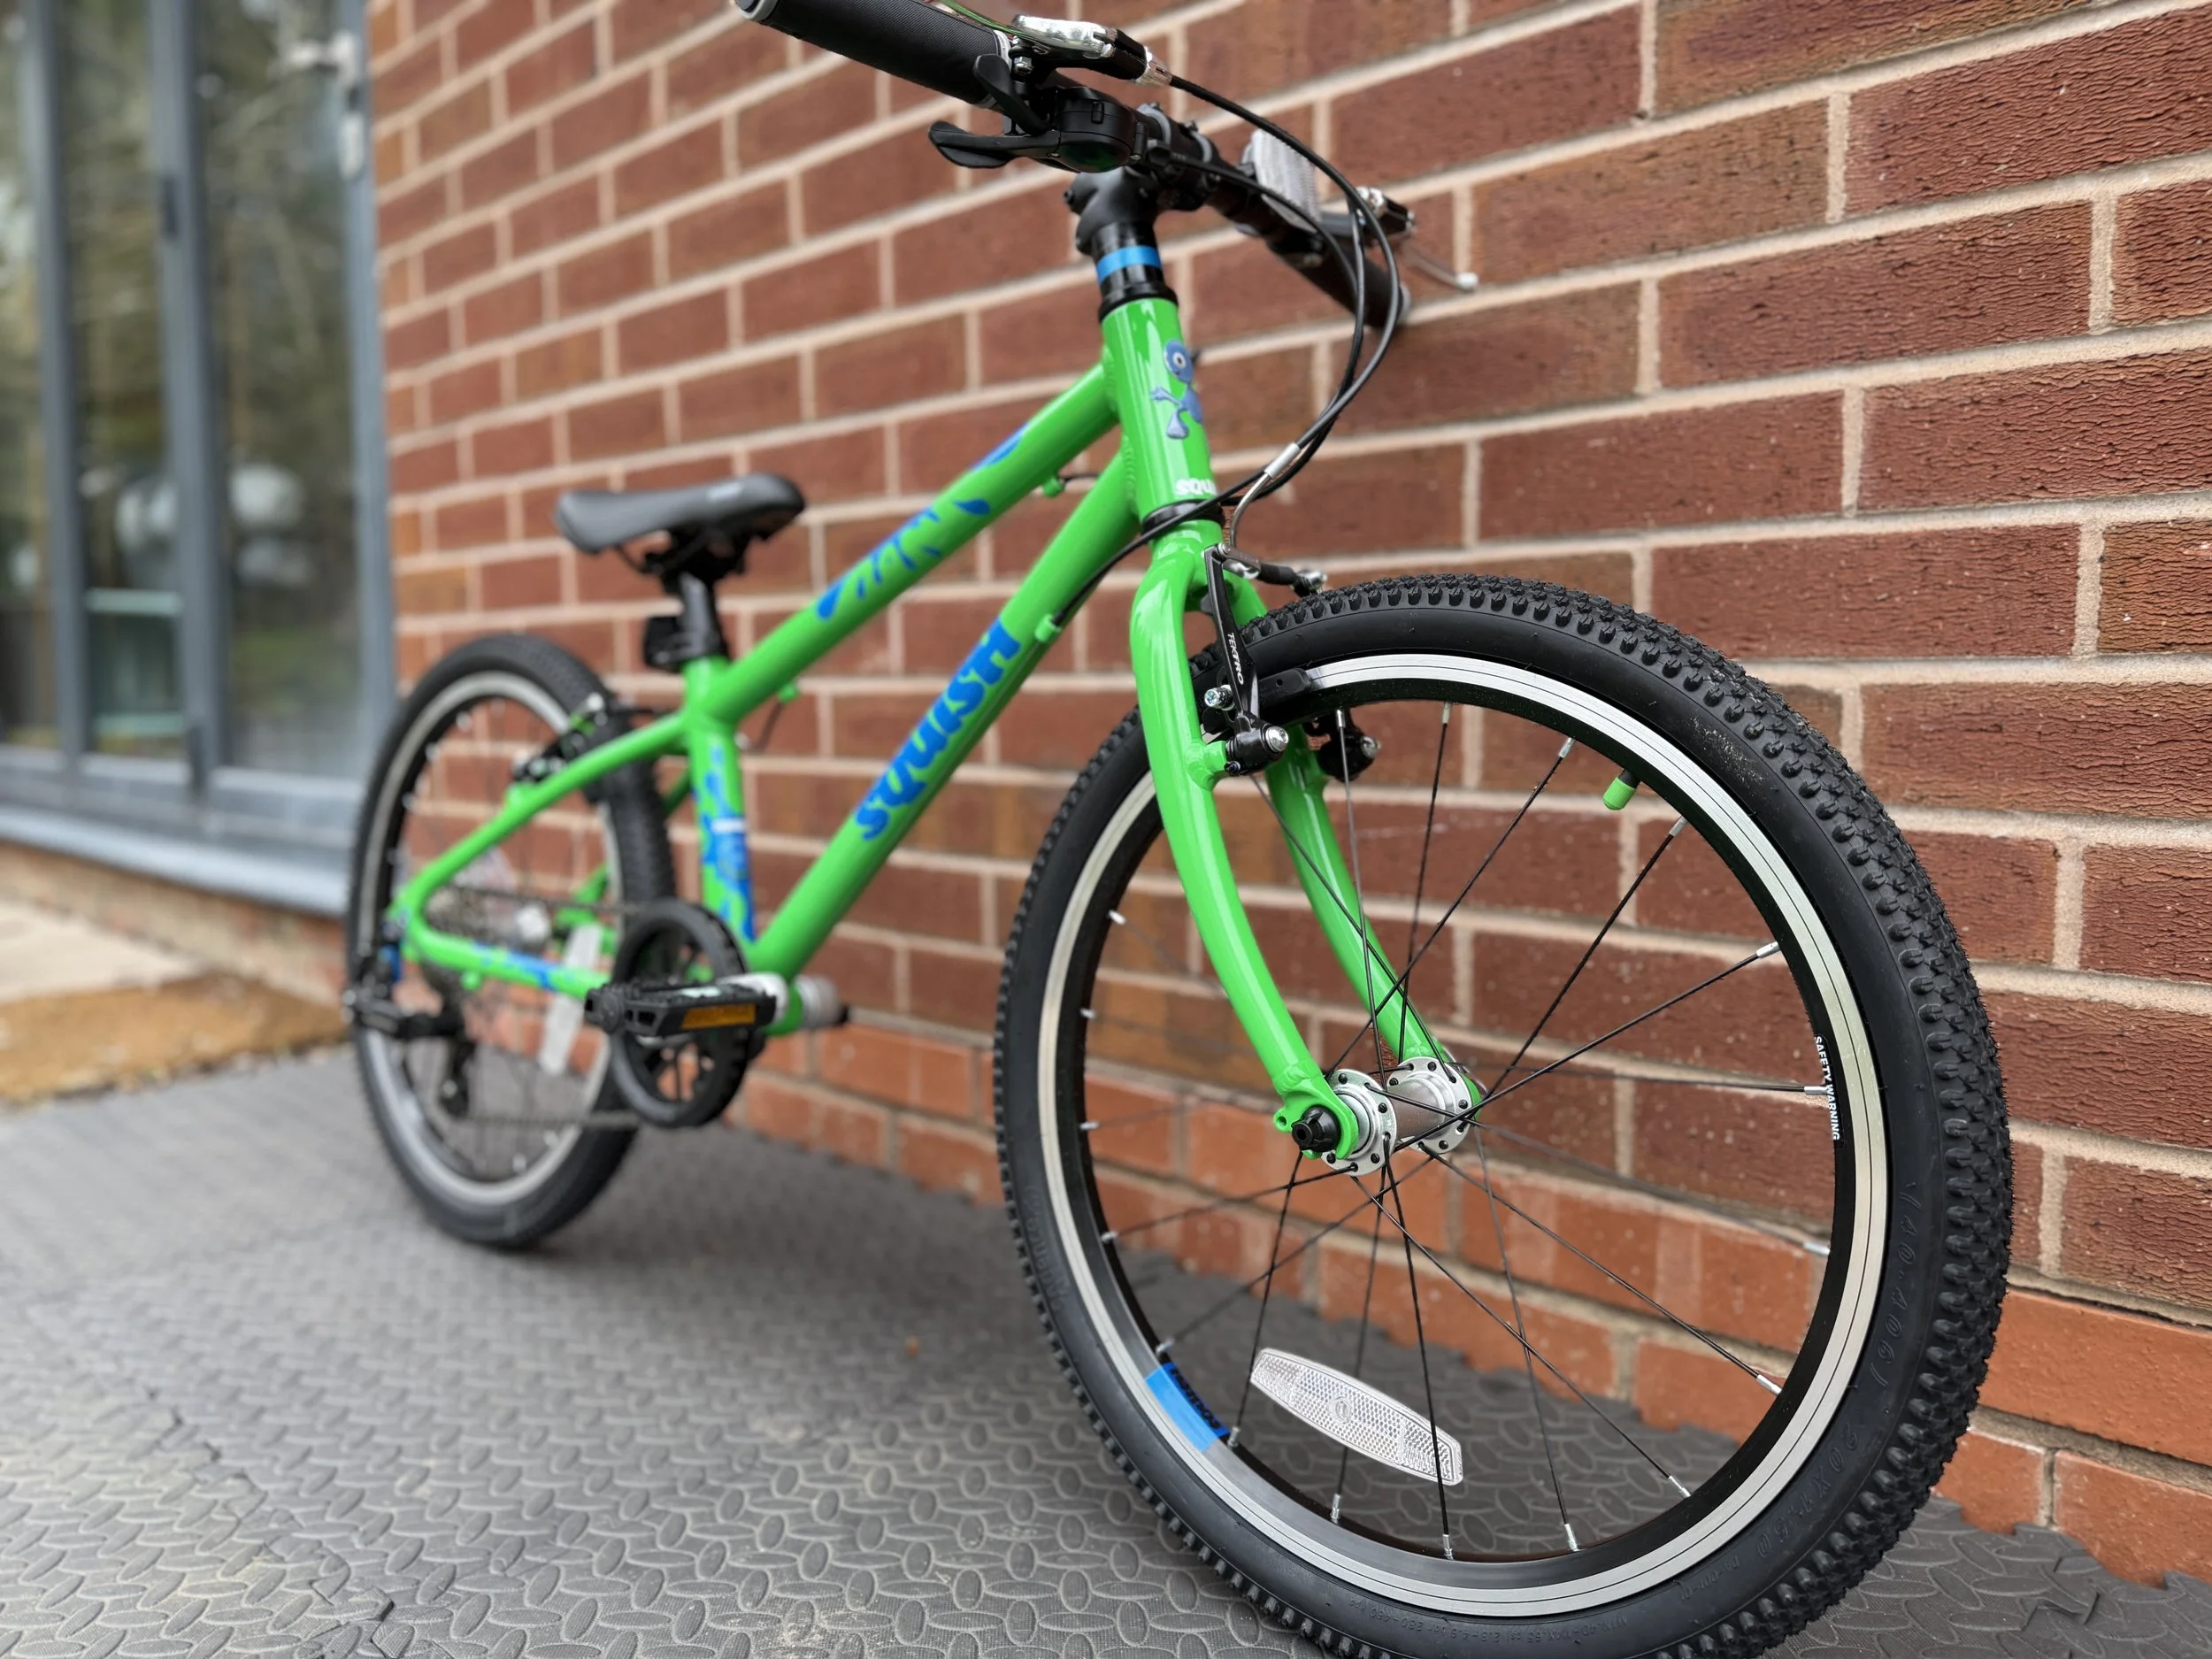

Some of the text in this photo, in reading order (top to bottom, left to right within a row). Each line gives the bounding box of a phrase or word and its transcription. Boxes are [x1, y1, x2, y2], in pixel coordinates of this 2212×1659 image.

[1175, 477, 1217, 495] SQU
[1227, 632, 1244, 686] TEKTRO
[1815, 1035, 1840, 1141] SAFETY WARNING
